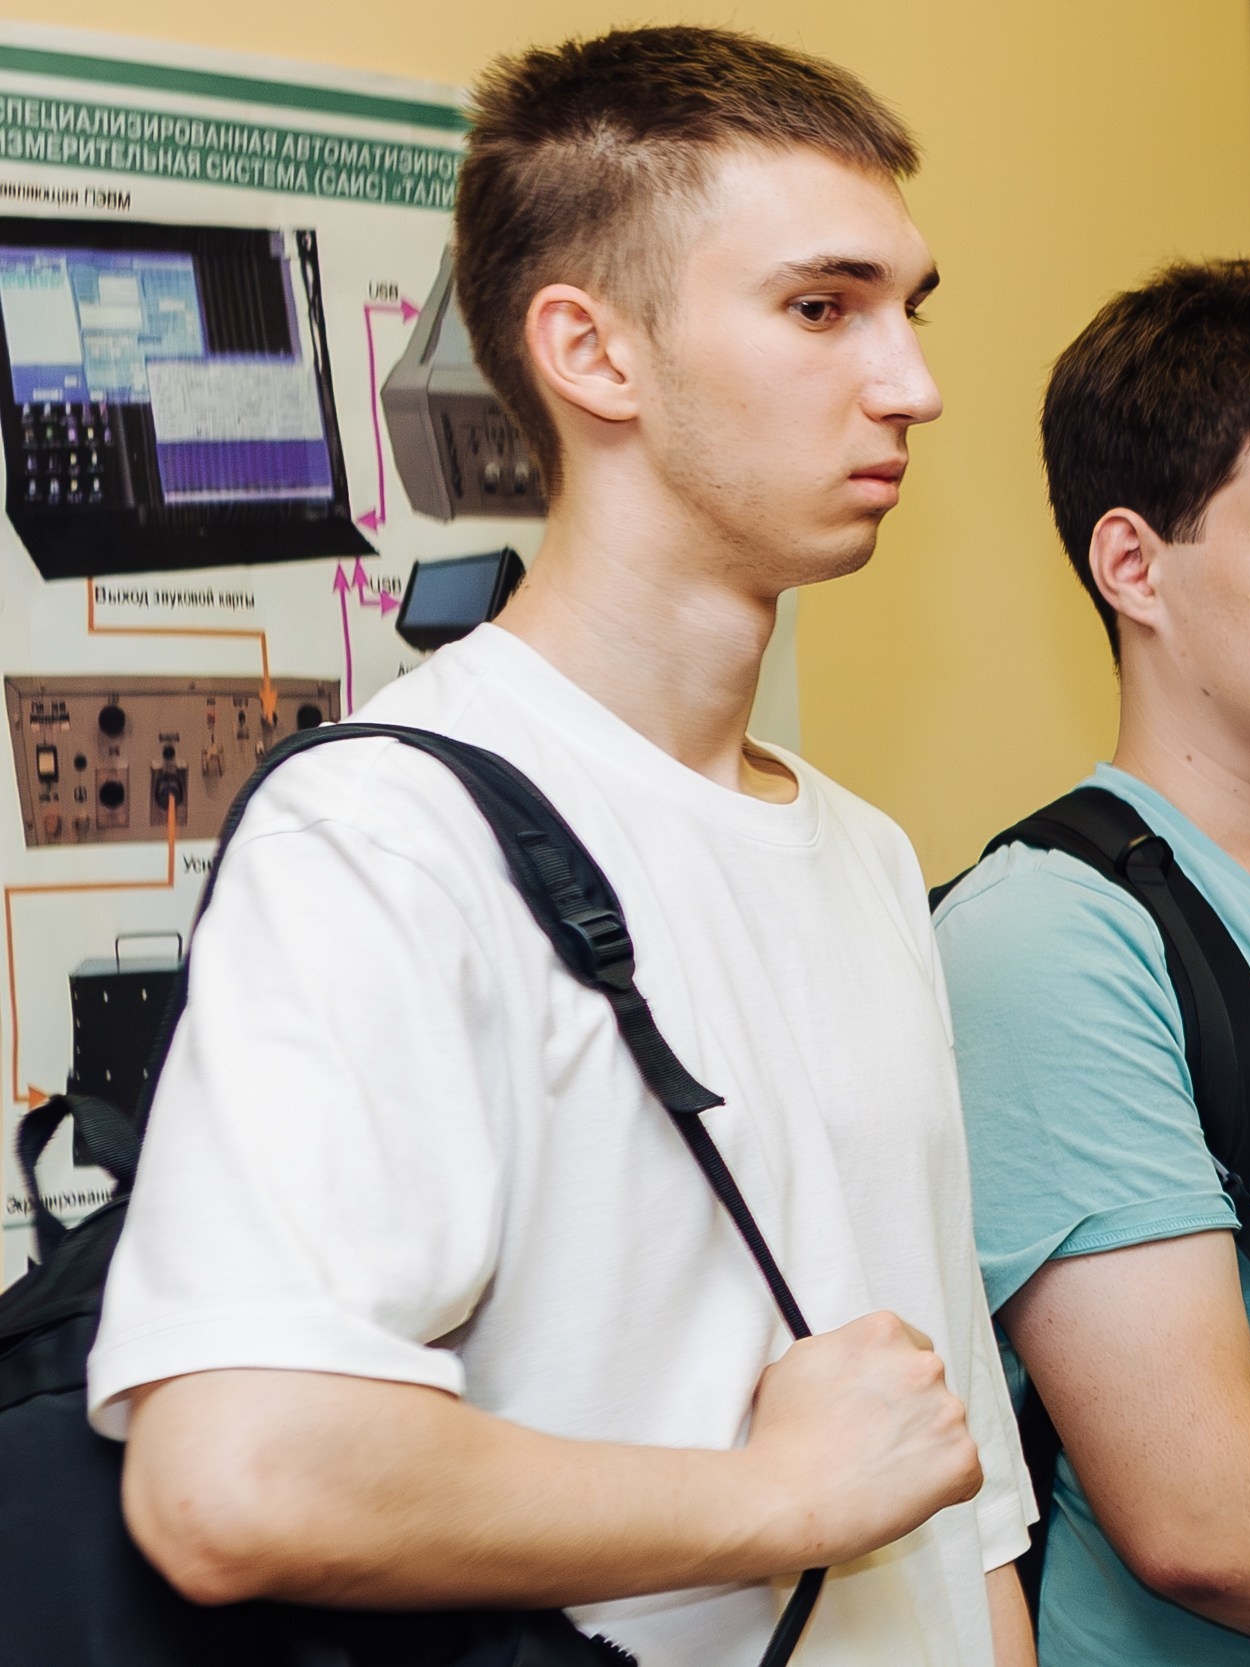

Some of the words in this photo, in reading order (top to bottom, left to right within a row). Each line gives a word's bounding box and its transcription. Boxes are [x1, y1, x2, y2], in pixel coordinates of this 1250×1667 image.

[206, 151, 308, 191] СИСТЕМА
[369, 279, 399, 300] USB
[370, 574, 401, 594] USB
[94, 584, 149, 608] Выход
[153, 584, 214, 609] звуковой
[219, 588, 255, 612] карты
